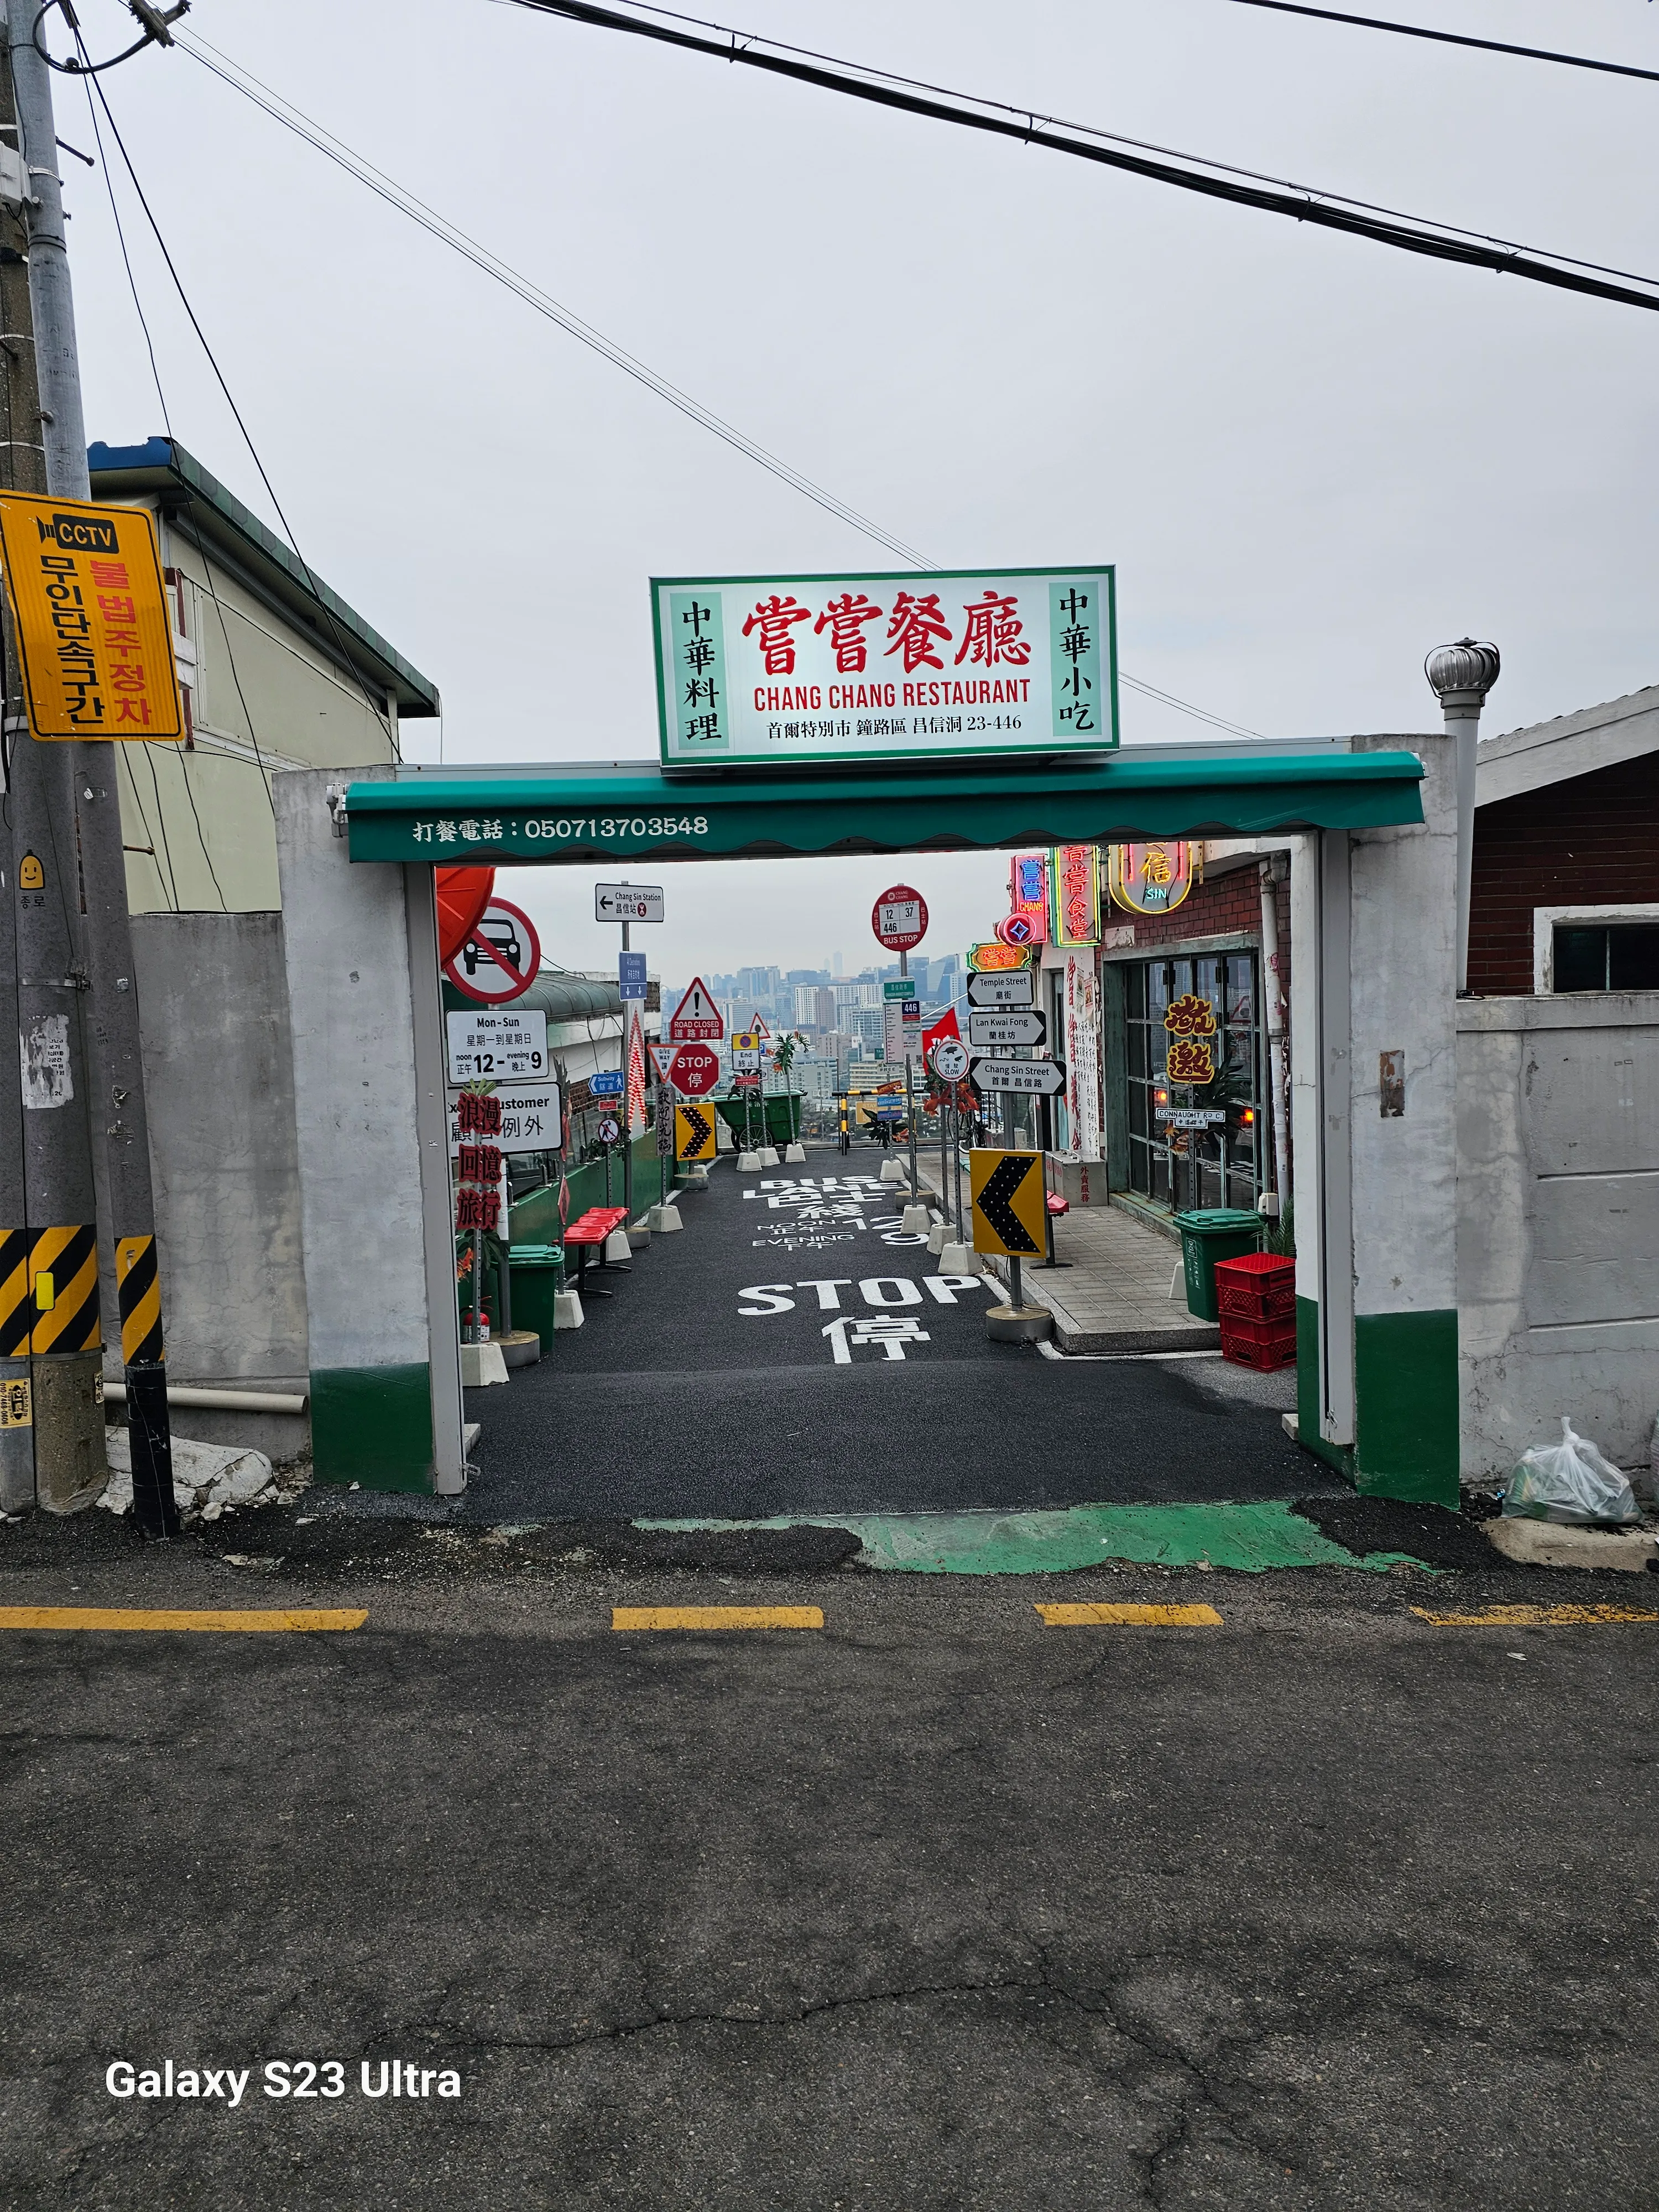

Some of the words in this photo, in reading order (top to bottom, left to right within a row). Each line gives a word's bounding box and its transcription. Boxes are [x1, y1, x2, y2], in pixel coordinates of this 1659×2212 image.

[59, 523, 112, 547] CCTV
[40, 555, 105, 724] 무인단속구간
[742, 590, 1031, 676] 嘗嘗餐廳
[90, 559, 152, 726] 불법주정차
[1058, 587, 1095, 731] 中華小吃
[683, 601, 722, 741] 中華料理
[754, 686, 821, 711] CHANG
[830, 684, 895, 708] CHANG
[904, 679, 1030, 706] RESTAURANT
[766, 719, 851, 739] 首爾特別市
[856, 717, 907, 736] 鐘路區
[914, 716, 962, 734] 昌信洞
[967, 714, 1022, 731] 23-446
[1140, 842, 1172, 883] 信
[615, 892, 632, 901] Chang
[633, 893, 642, 901] Sin
[1146, 887, 1167, 899] SIN
[20, 896, 45, 909] 종로
[616, 903, 636, 914] 昌信站
[1019, 902, 1044, 912] CHANG
[886, 909, 894, 920] 12
[905, 907, 914, 917] 37
[884, 922, 897, 933] 446
[899, 935, 918, 943] STOP
[980, 978, 1005, 988] Temple
[1006, 977, 1027, 985] Street
[996, 991, 1011, 1000] 廟街
[904, 1003, 917, 1012] 446
[1010, 1018, 1029, 1027] Fong
[467, 1033, 531, 1046] 星期一到星期日
[989, 1031, 1016, 1040] 蘭桂坊
[457, 1064, 472, 1074] 正午
[512, 1062, 526, 1072] 晚上
[473, 1054, 494, 1073] 12
[507, 1051, 529, 1060] evening
[531, 1051, 542, 1069] 9
[677, 1057, 712, 1068] STOP
[984, 1065, 1010, 1075] Chang
[1011, 1066, 1024, 1074] Sin
[1025, 1067, 1050, 1076] Street
[687, 1072, 702, 1088] 停
[992, 1077, 1009, 1086] 首爾
[1014, 1078, 1042, 1088] 昌信路
[500, 1097, 550, 1110] ustomer
[460, 1095, 499, 1132] 浪漫
[460, 1146, 500, 1182] 回憶
[760, 1175, 878, 1190] BUS
[1080, 1166, 1091, 1203] 外賣服務
[743, 1182, 904, 1199] LANE
[767, 1191, 886, 1209] 巴士
[457, 1191, 499, 1227] 旅行
[757, 1219, 836, 1230] NOON
[842, 1216, 903, 1230] 12
[770, 1226, 824, 1235] 正午
[752, 1234, 855, 1246] EVENING
[880, 1231, 930, 1245] 9
[737, 1275, 982, 1316] STOP
[821, 1314, 931, 1364] 停
